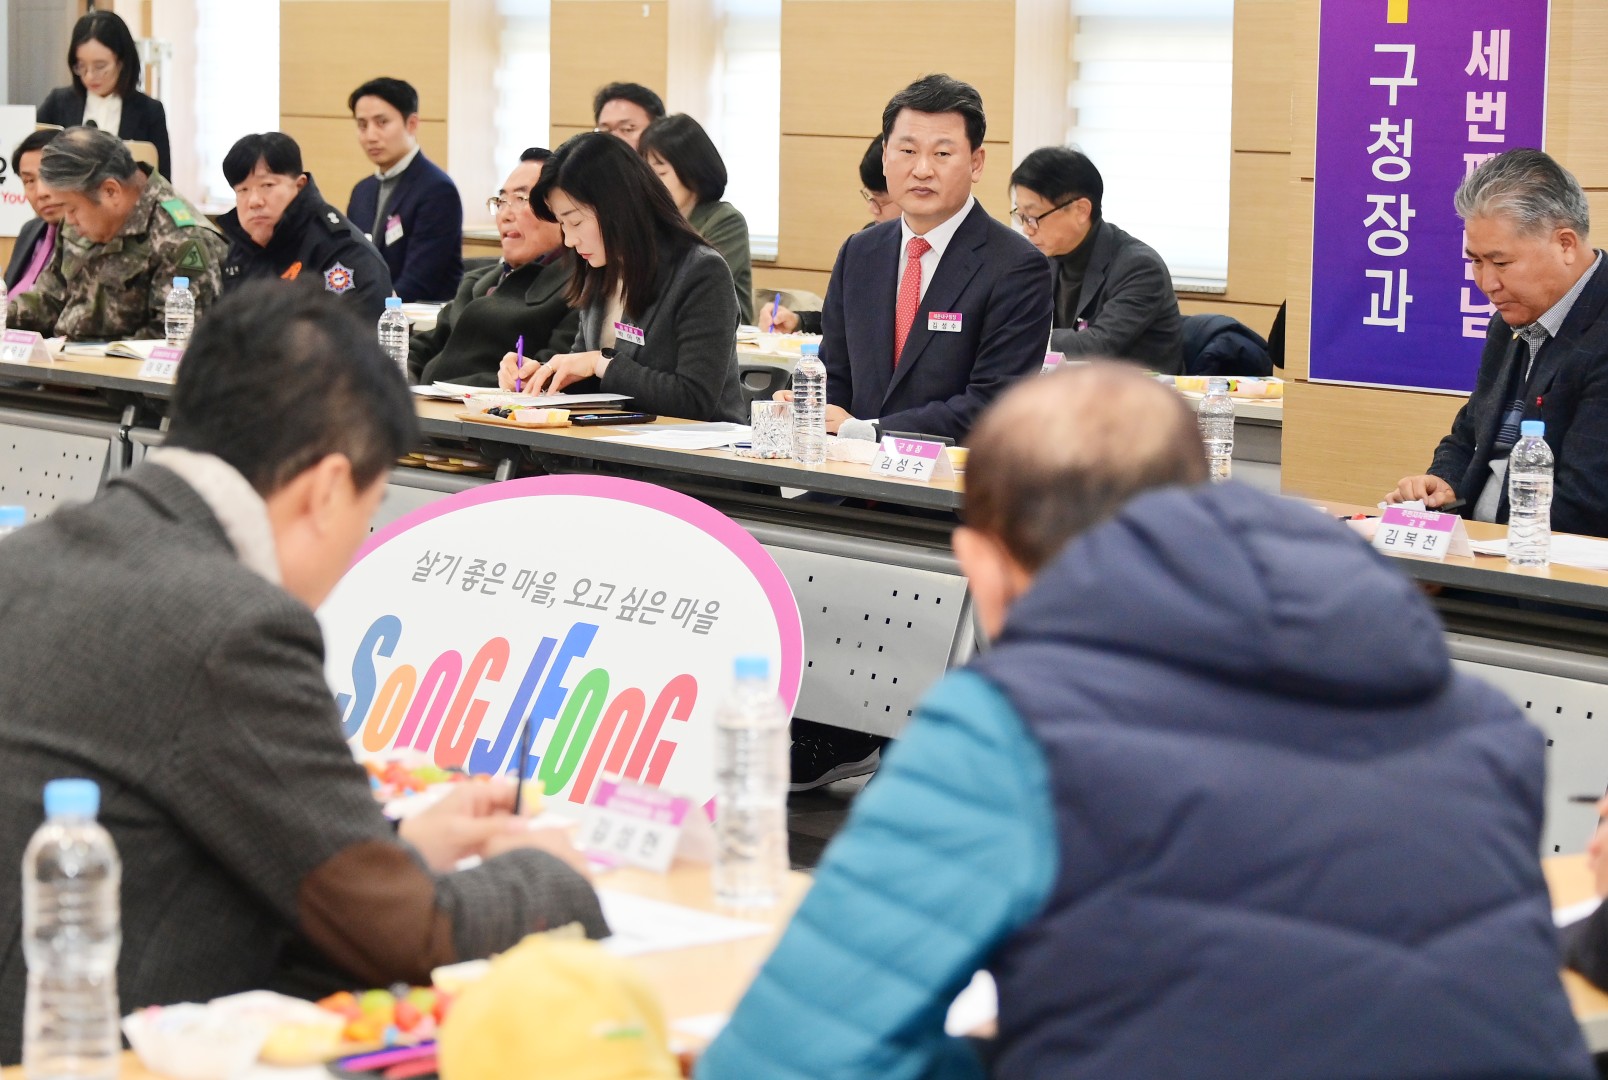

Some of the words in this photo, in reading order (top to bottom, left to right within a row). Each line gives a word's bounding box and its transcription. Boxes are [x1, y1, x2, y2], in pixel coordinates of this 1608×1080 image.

[1363, 43, 1418, 333] 구청장과
[881, 456, 924, 475] 김성수
[1385, 529, 1438, 551] 김복천
[411, 550, 463, 585] 살기
[462, 558, 507, 595] 좋은
[511, 569, 557, 608] 마을,
[563, 578, 616, 611] 오고
[615, 587, 668, 625] 싶은
[671, 598, 721, 635] 마을
